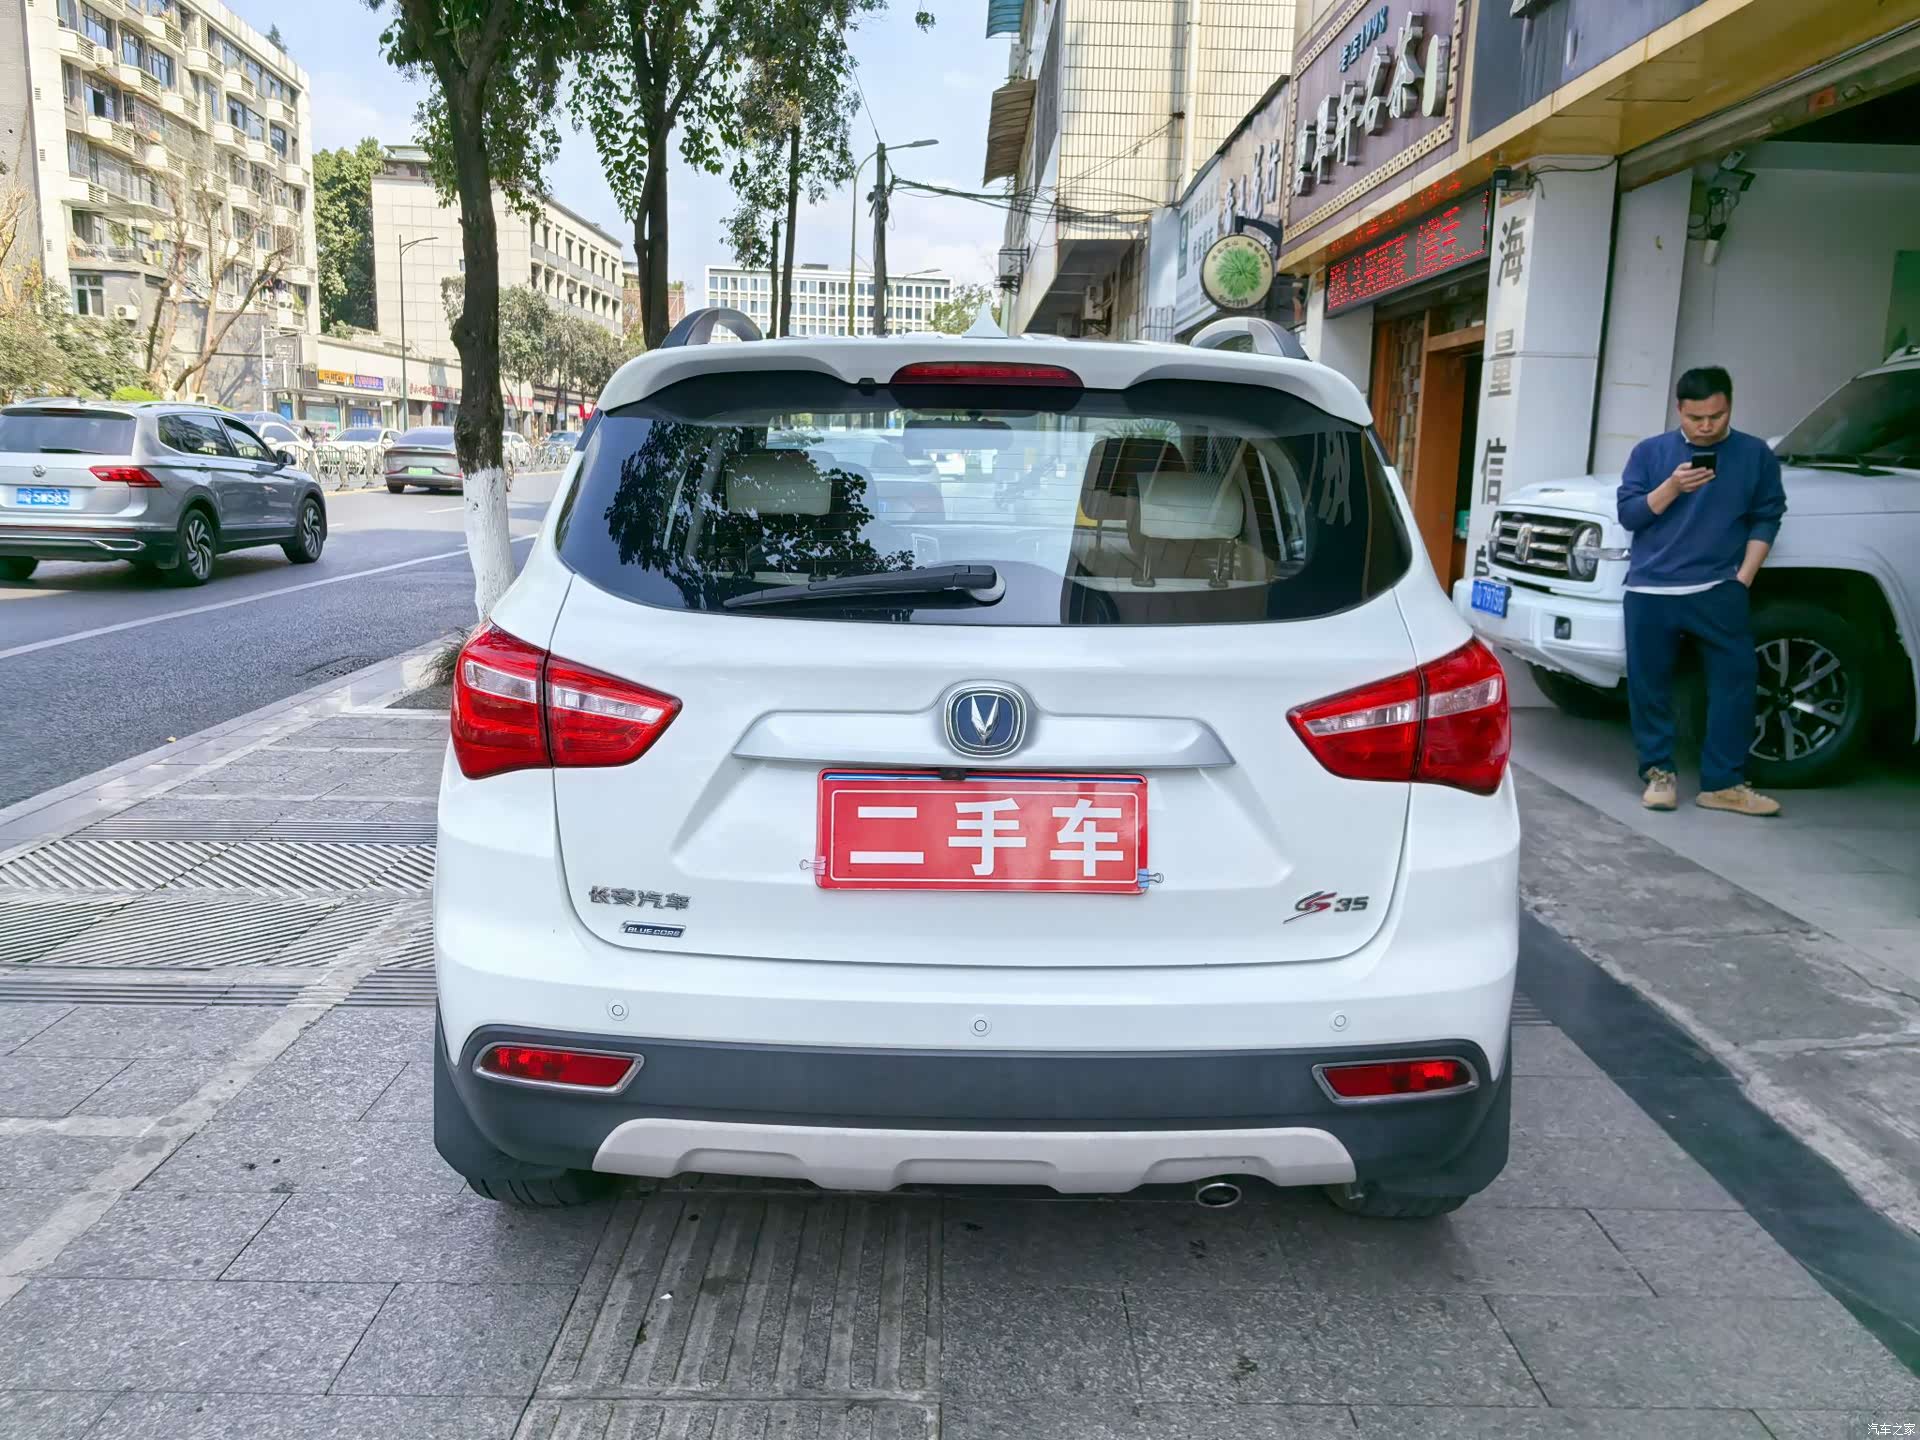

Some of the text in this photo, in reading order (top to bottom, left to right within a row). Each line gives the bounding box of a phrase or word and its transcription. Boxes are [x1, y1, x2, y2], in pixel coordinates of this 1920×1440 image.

[850, 797, 1124, 877] 二手车
[589, 885, 691, 911] 长安汽车
[627, 926, 653, 934] BLUE
